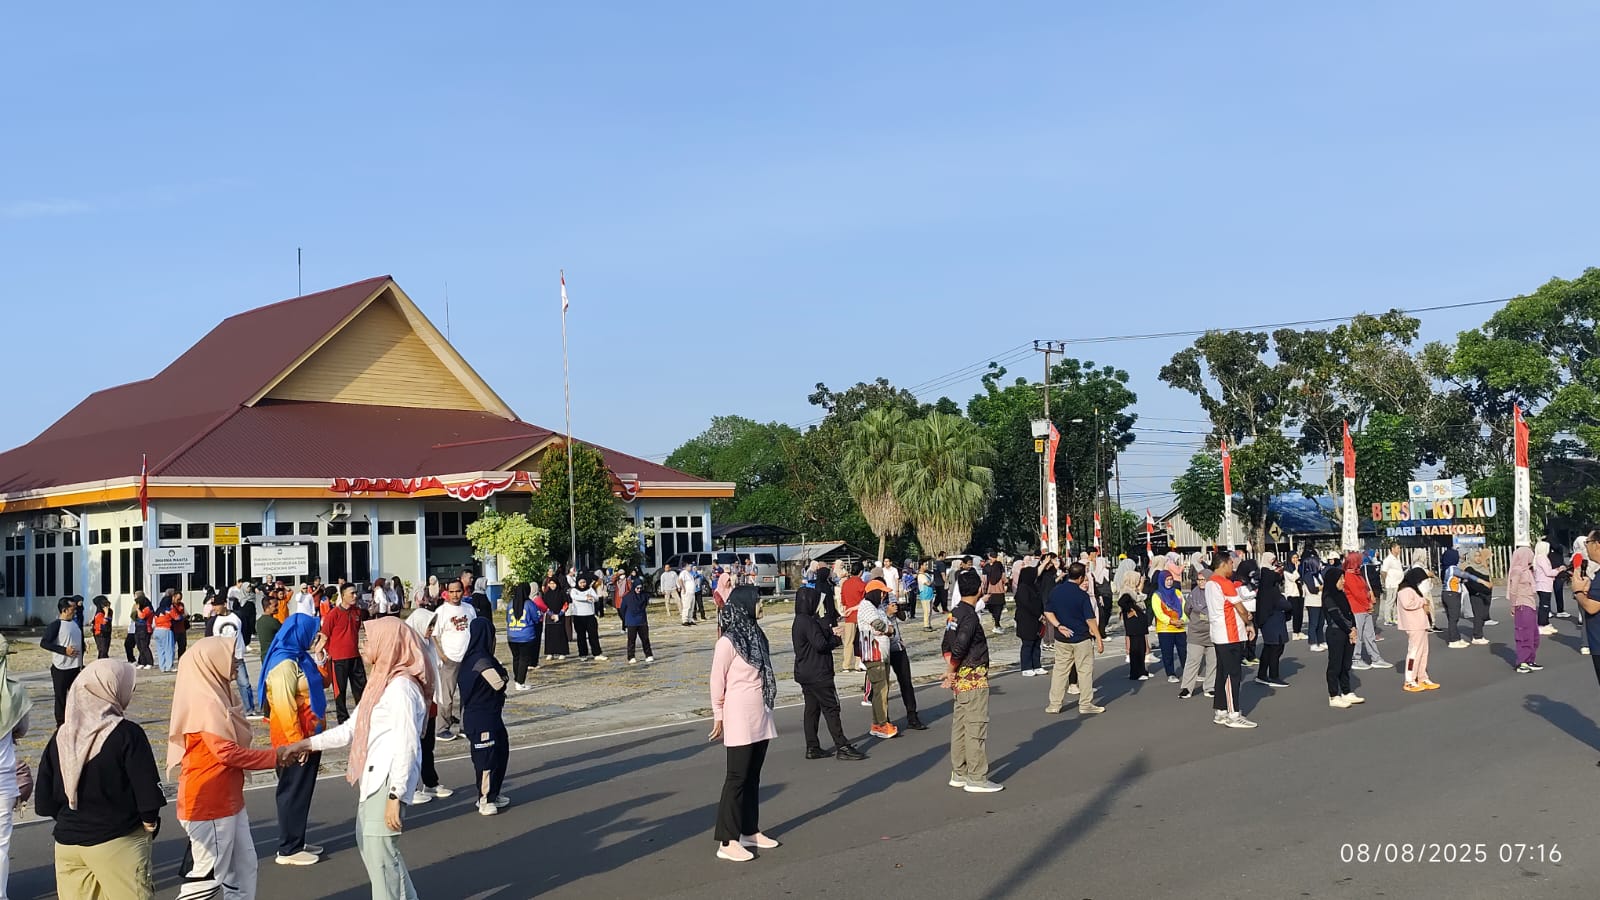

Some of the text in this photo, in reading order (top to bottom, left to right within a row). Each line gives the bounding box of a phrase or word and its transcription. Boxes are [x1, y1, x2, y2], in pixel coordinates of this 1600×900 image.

[1372, 497, 1497, 521] BERSIH KOTAKU
[1386, 524, 1484, 537] DARI NARKOBA
